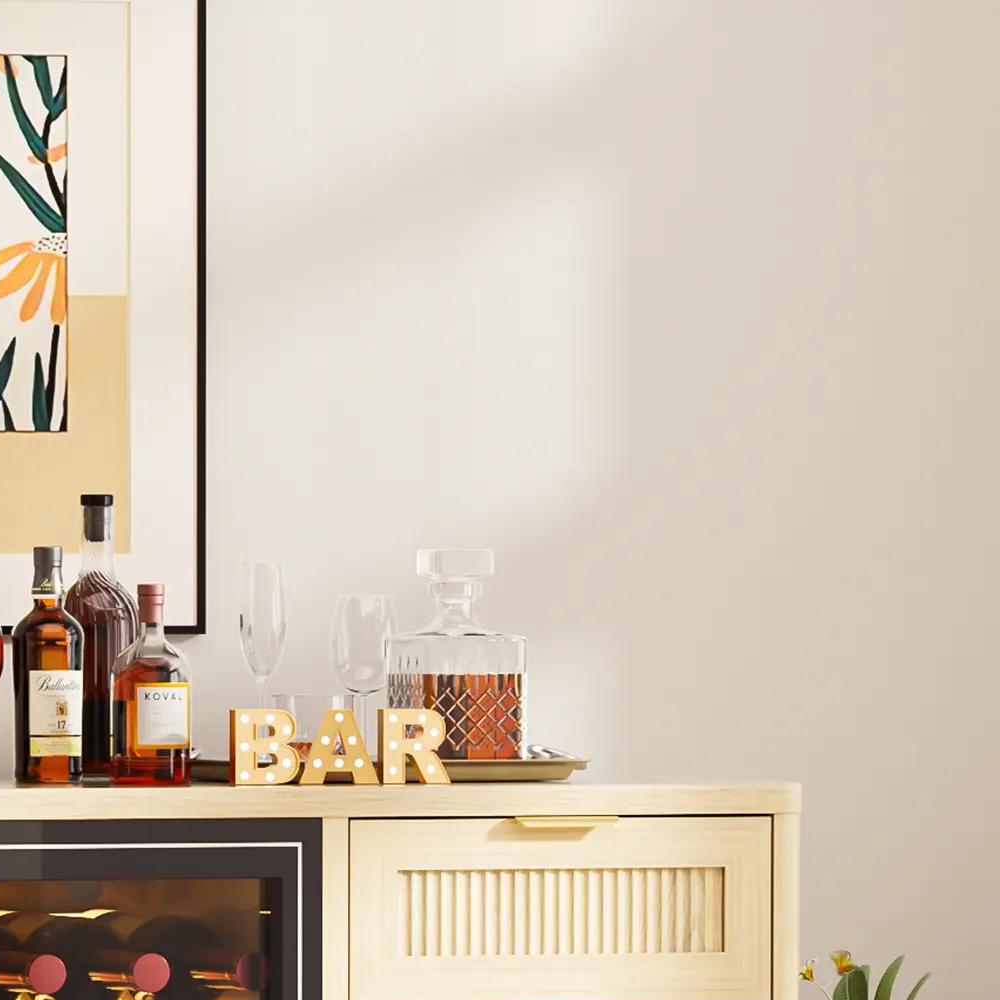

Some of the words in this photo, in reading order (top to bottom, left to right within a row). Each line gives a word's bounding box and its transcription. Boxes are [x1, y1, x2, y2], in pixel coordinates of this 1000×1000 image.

[144, 692, 183, 701] KOVAL
[57, 720, 67, 729] 17
[230, 709, 451, 785] BAR
